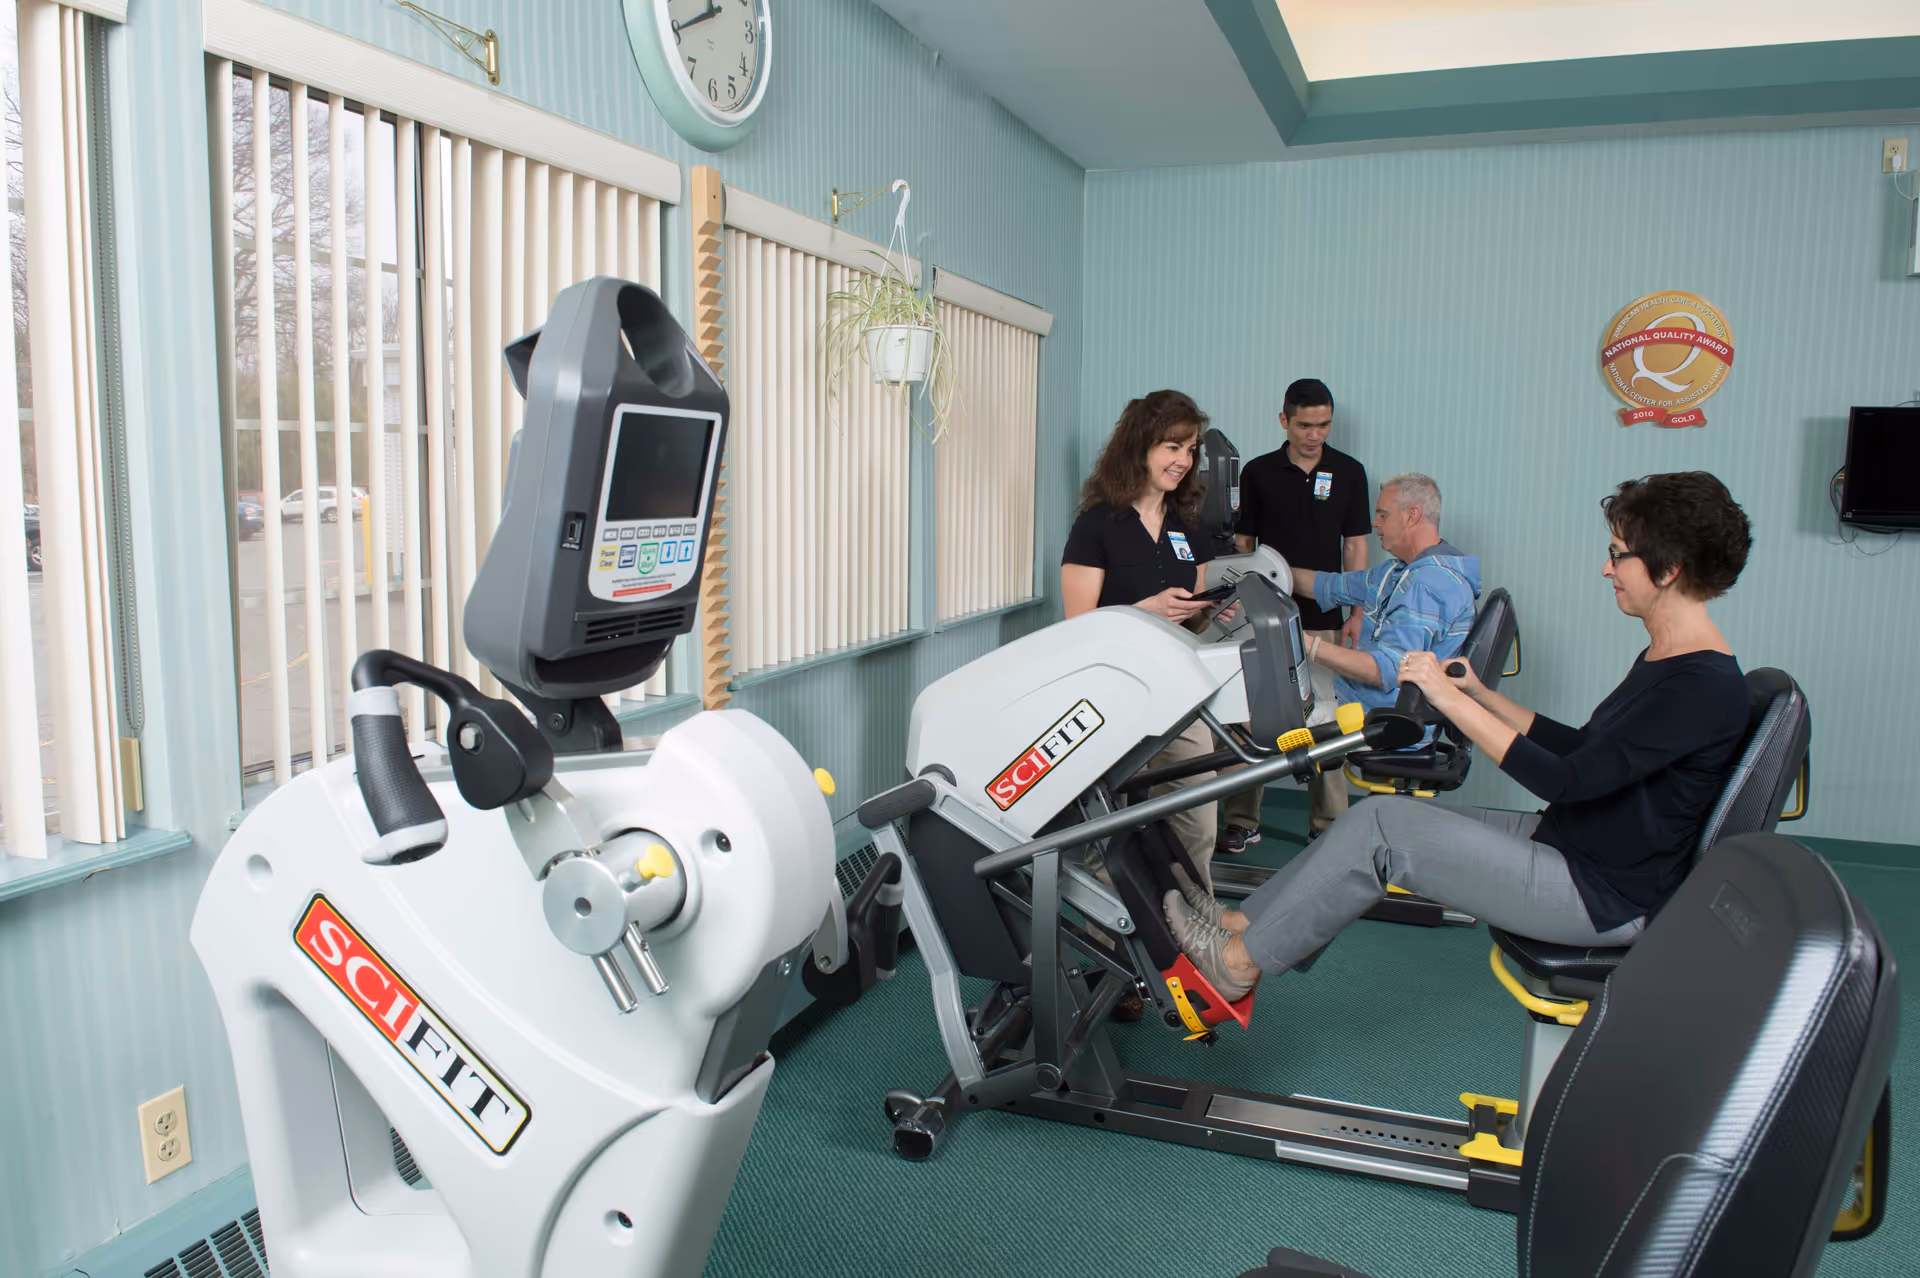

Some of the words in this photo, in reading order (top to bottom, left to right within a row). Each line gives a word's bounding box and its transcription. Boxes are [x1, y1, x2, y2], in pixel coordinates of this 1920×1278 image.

[744, 20, 754, 44] 3
[687, 56, 697, 81] 7
[738, 52, 749, 77] 4
[708, 78, 718, 102] 6
[727, 75, 737, 99] 5
[1613, 308, 1640, 338] AMERICAN
[1641, 297, 1669, 310] HEALTH
[1670, 296, 1690, 305] CARE
[1691, 301, 1725, 338] ASSOCIATION
[1604, 333, 1651, 358] NATIONAL
[1652, 331, 1696, 341] QUALITY
[1696, 336, 1728, 355] AWARD
[1609, 362, 1630, 394] NATIONAL
[1629, 391, 1657, 406] CENTER
[1675, 384, 1710, 406] ASSISTED
[1708, 362, 1725, 385] LIVING
[1632, 410, 1655, 420] 2010
[1671, 414, 1696, 424] GOLD
[996, 709, 1089, 803] SCIFIT
[308, 919, 511, 1124] SCIFIT
